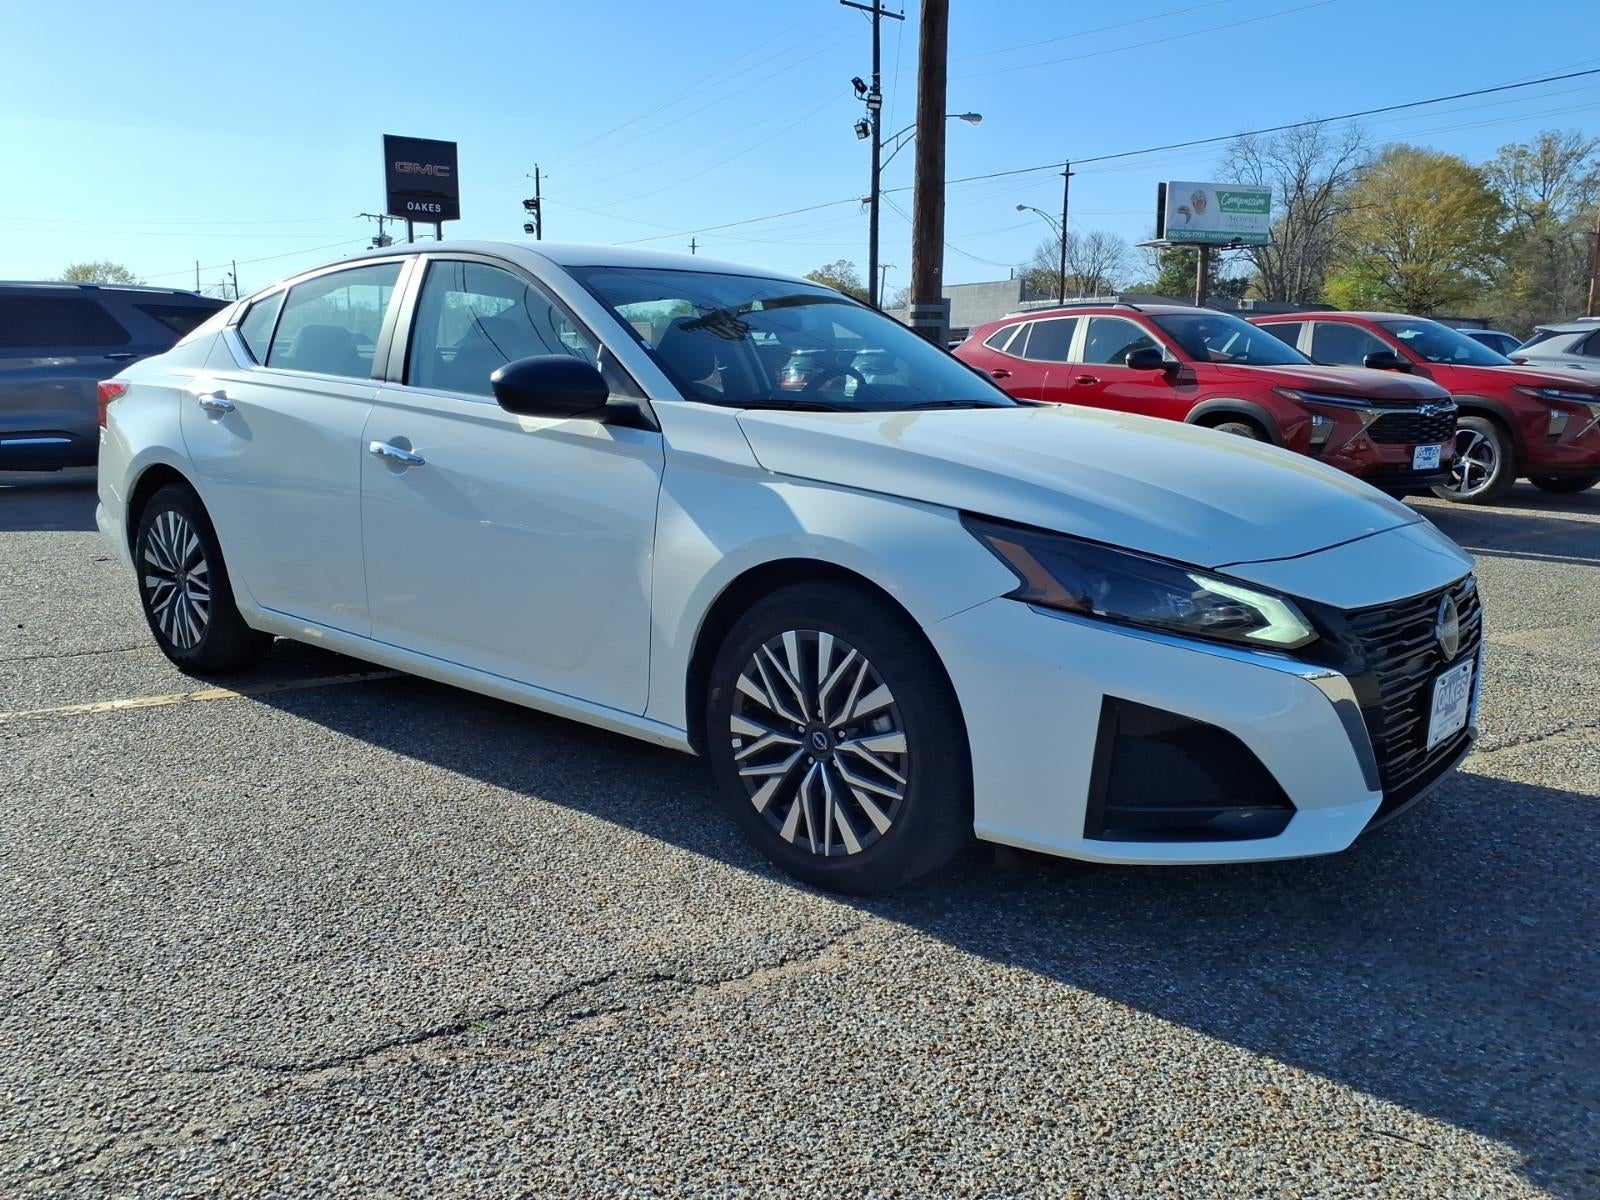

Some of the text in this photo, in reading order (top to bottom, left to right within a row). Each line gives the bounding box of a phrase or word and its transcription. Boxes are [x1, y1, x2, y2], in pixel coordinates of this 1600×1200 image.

[395, 161, 450, 177] GMC
[407, 201, 441, 213] OAKES
[1439, 677, 1467, 709] OAKES
